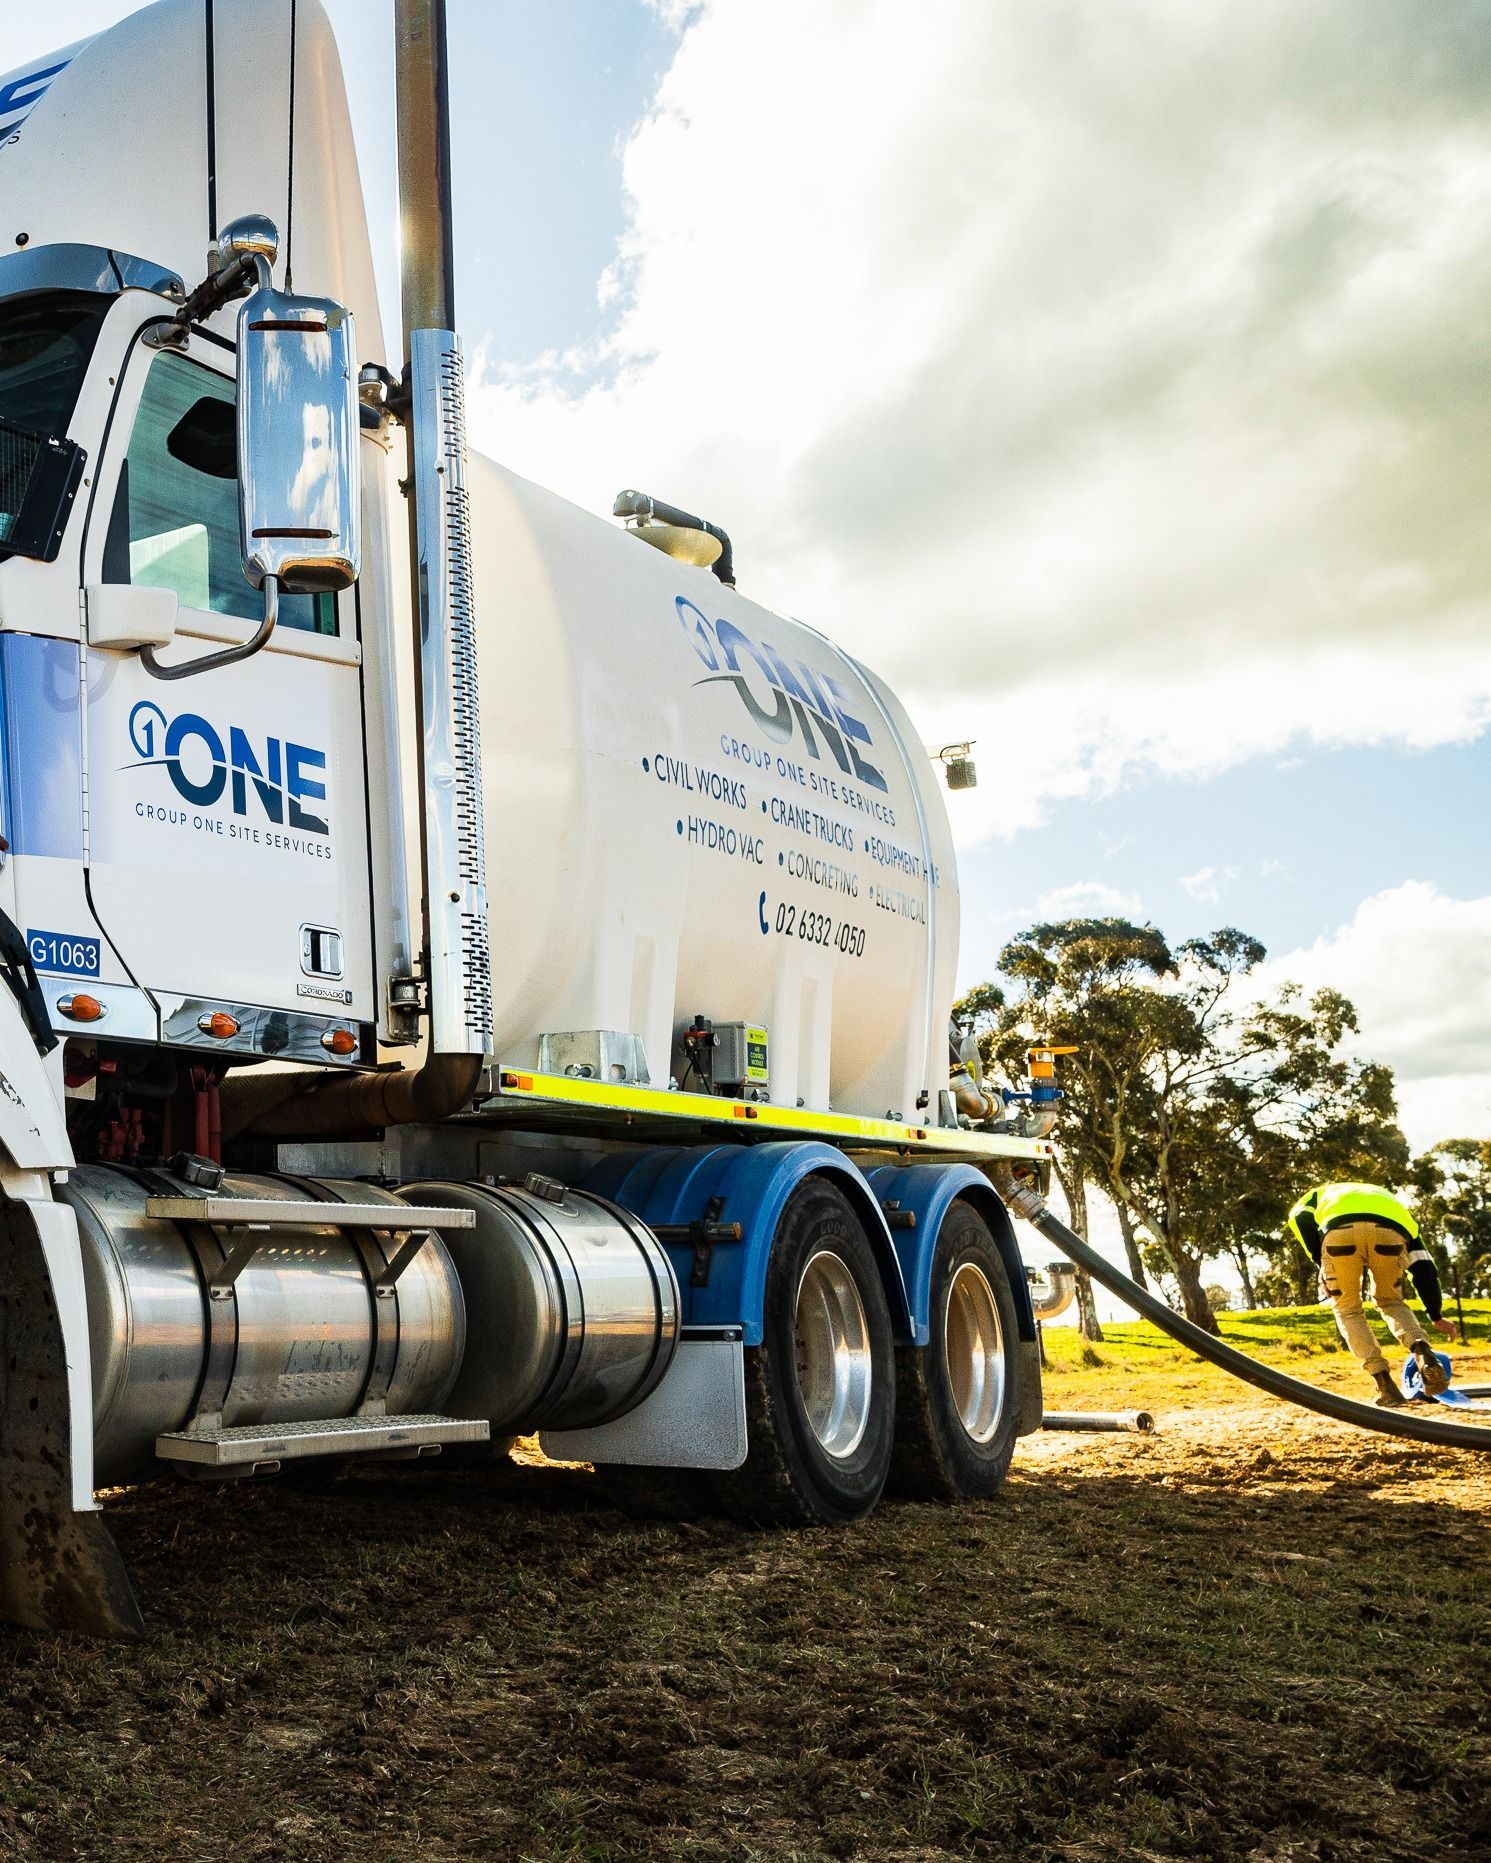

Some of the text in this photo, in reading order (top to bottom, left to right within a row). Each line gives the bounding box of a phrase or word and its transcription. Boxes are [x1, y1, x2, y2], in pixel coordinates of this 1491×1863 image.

[715, 618, 888, 793] ONE
[164, 713, 329, 835] ONE
[720, 734, 896, 827] GROUP ONE SITE SERVICES
[135, 802, 332, 860] GROUP ONE SITE SERVICES
[654, 753, 694, 791] CIVIL
[694, 766, 747, 810] WORKS
[771, 797, 811, 835] CRANE
[812, 813, 854, 852] TRUCKS
[871, 836, 920, 879] EQUIPMENT
[775, 902, 796, 937] 02
[798, 909, 832, 947] 6332
[787, 850, 859, 898] CONCRETING
[876, 884, 926, 925] ELECTRICAL
[29, 936, 98, 970] G1063
[300, 986, 344, 999] CORONADO
